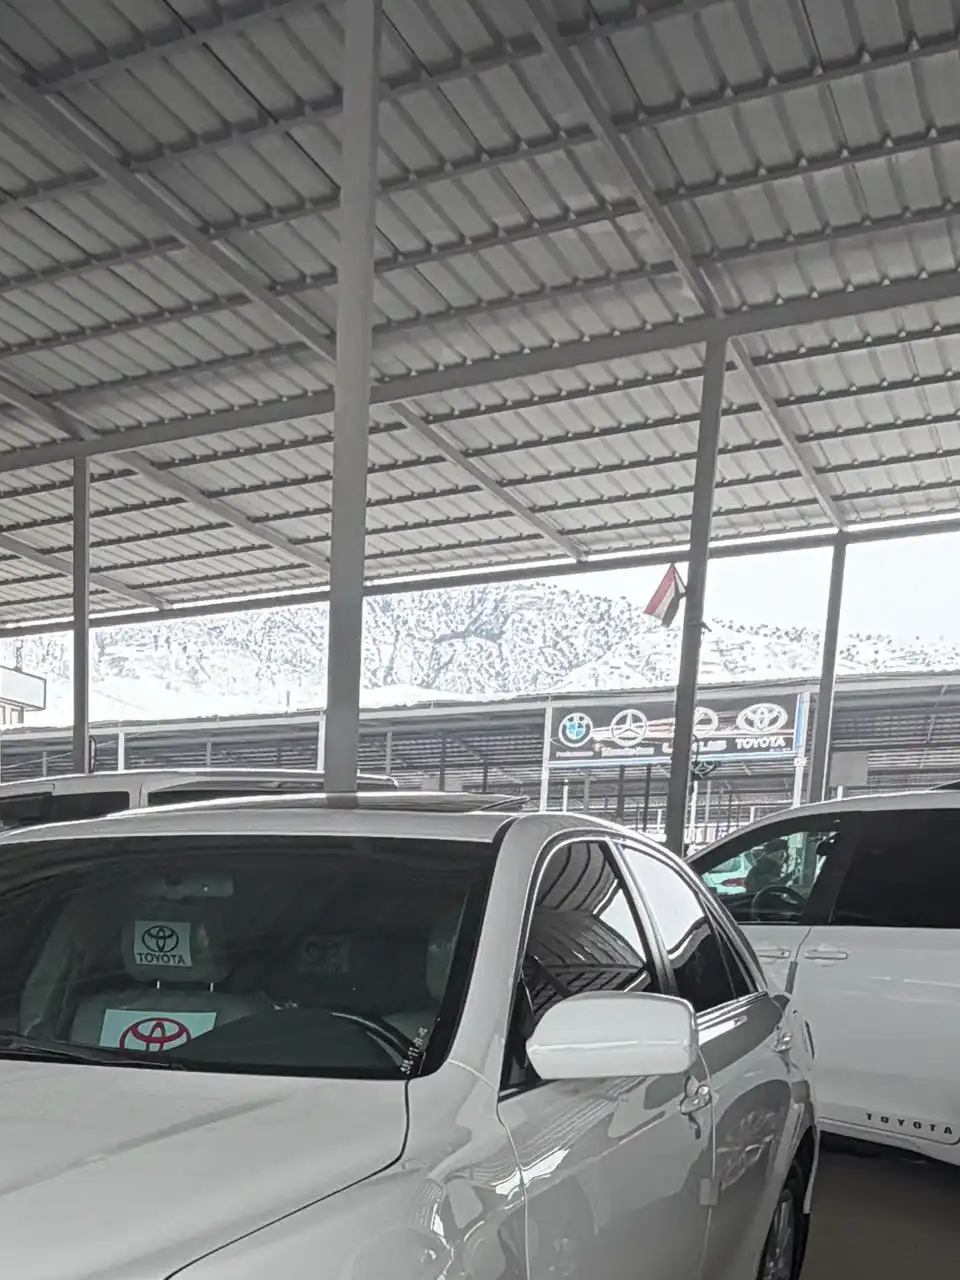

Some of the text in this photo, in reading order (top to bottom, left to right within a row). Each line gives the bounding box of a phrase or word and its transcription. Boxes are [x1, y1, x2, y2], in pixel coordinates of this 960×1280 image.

[735, 736, 786, 750] TOYOTA
[136, 952, 186, 965] TOYOTA
[865, 1112, 953, 1135] TOYOTA
